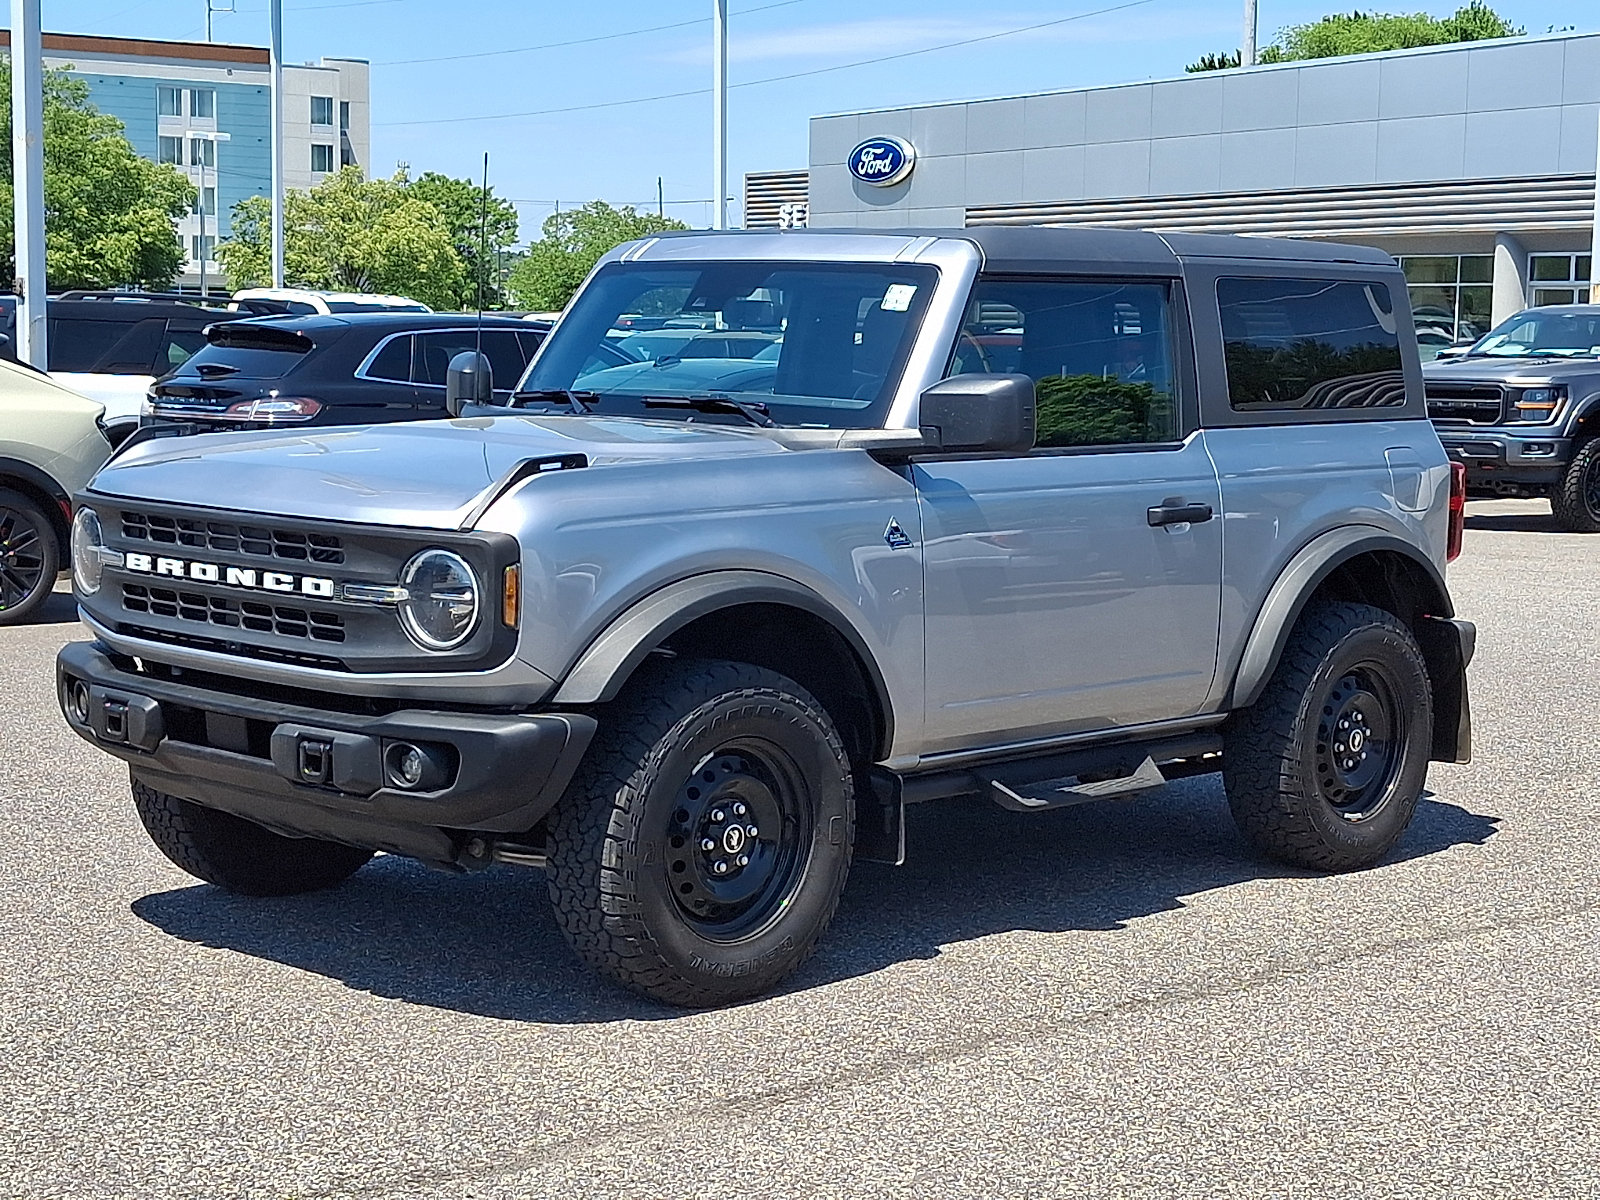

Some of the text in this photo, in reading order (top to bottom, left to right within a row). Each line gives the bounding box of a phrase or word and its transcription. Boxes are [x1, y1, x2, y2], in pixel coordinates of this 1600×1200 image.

[858, 147, 893, 175] Ford
[779, 204, 810, 229] SE
[126, 552, 334, 597] BRONCO
[688, 934, 794, 978] GENERAL
